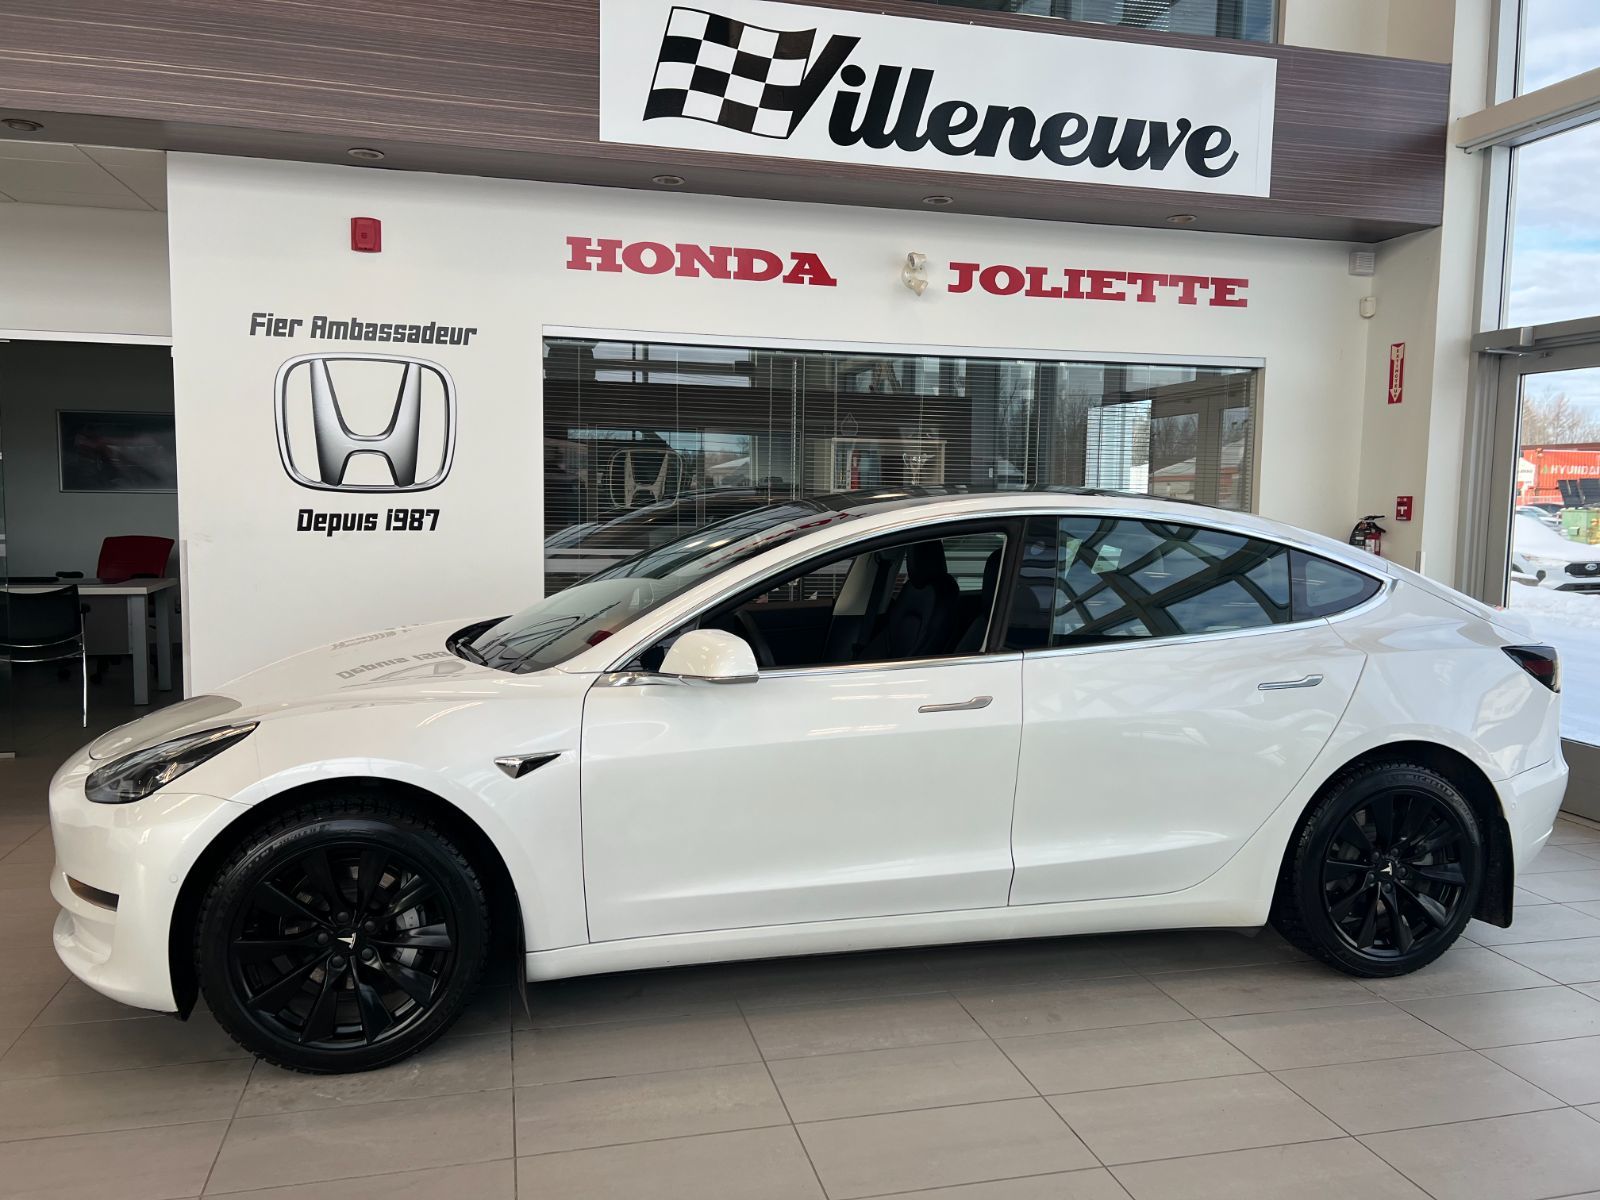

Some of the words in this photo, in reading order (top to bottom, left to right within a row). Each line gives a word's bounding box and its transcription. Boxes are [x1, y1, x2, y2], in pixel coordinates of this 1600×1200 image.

[786, 33, 1239, 178] Villeneuve
[566, 237, 837, 286] HONDA
[948, 262, 1248, 308] JOLIETTE
[249, 312, 303, 338] Fier
[310, 315, 478, 346] Ambassadeur
[296, 508, 379, 537] Depuis
[385, 508, 440, 532] 1987
